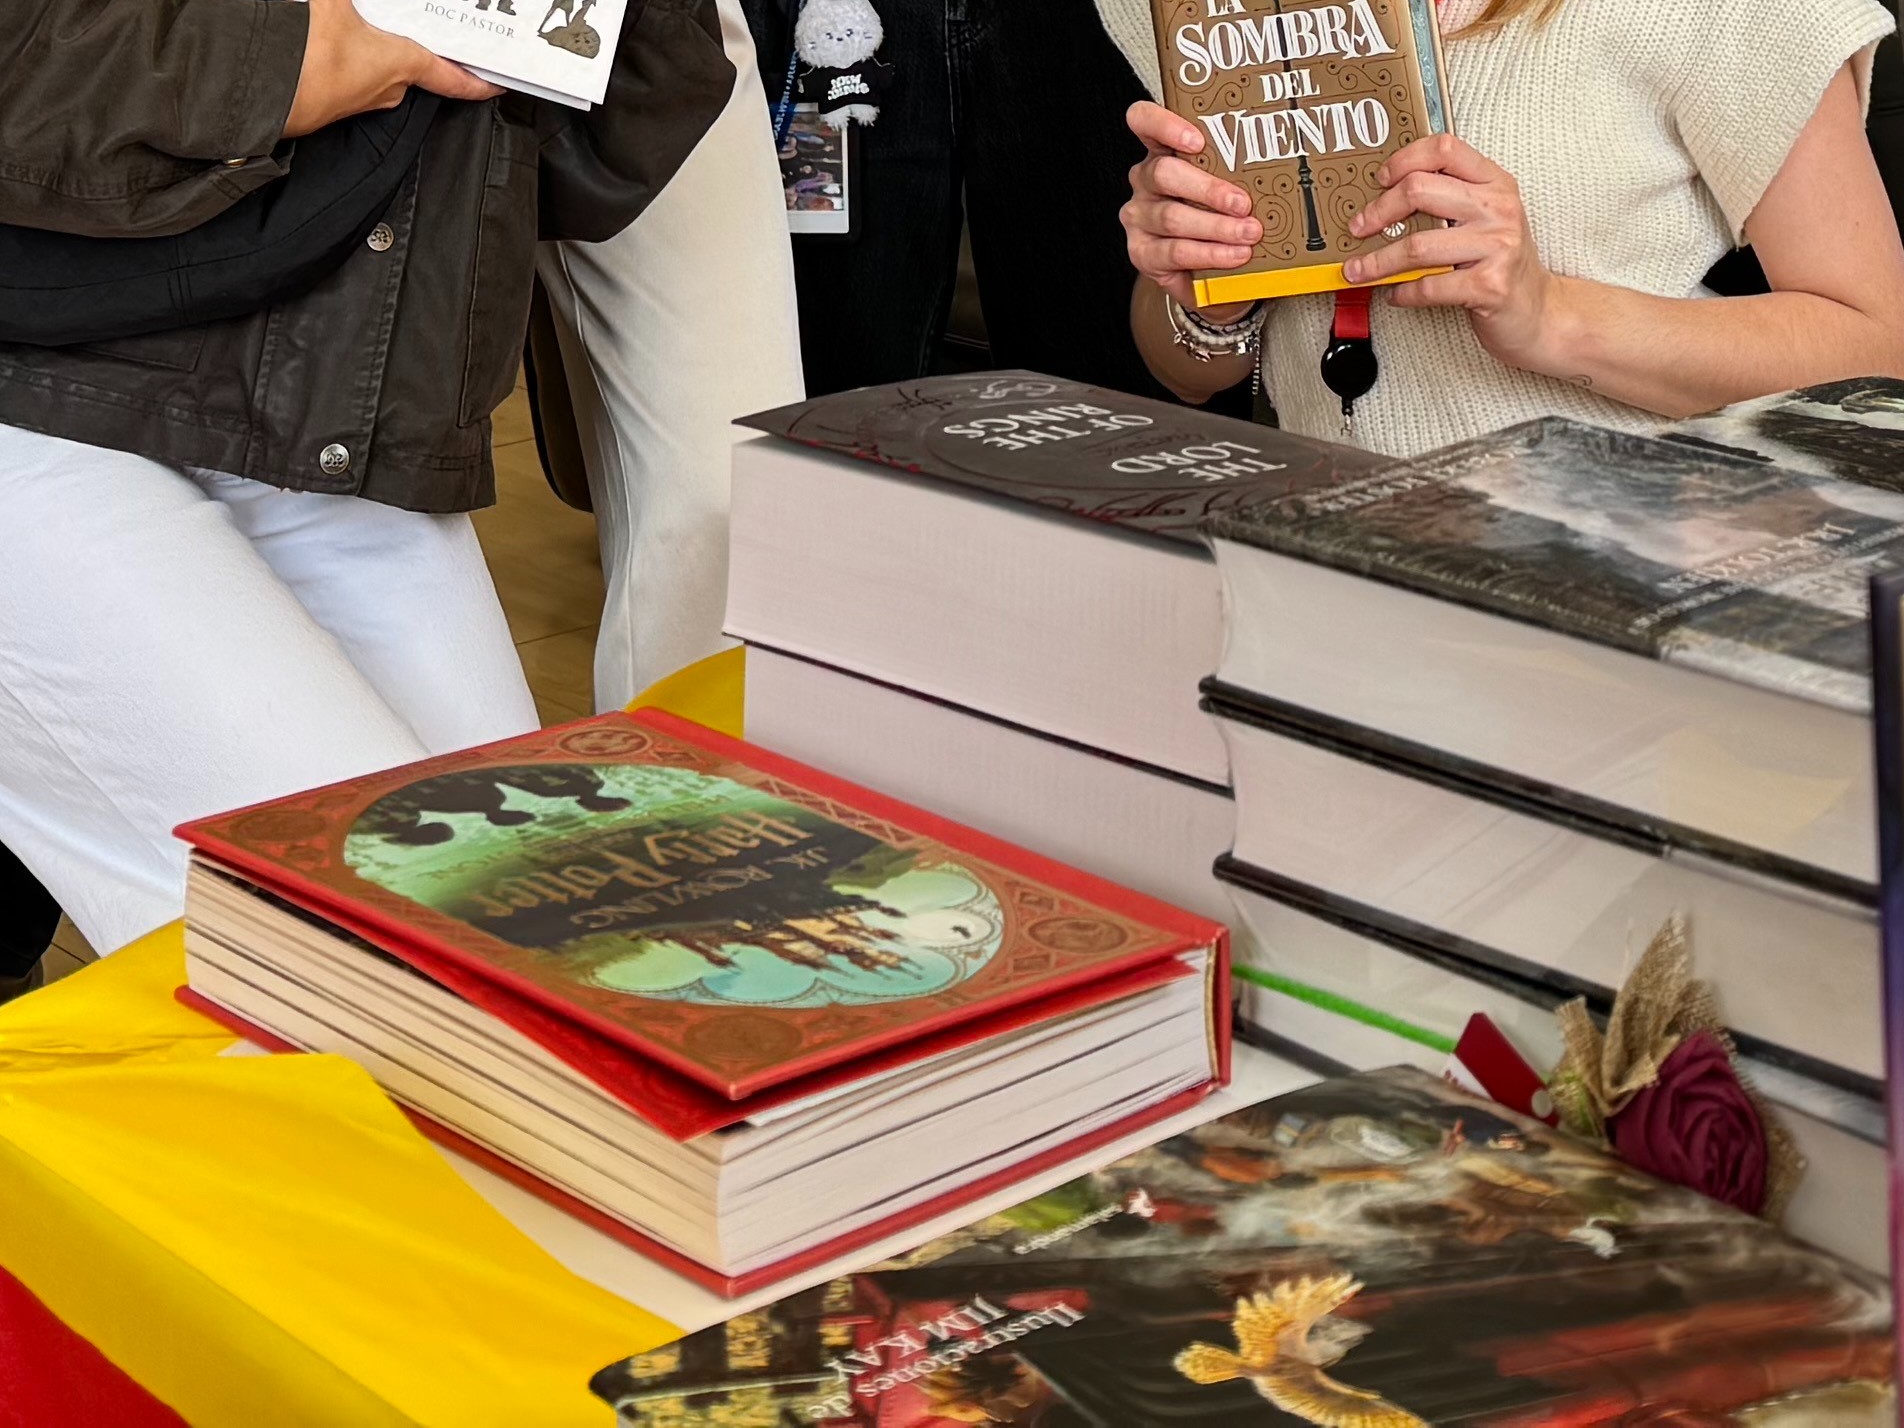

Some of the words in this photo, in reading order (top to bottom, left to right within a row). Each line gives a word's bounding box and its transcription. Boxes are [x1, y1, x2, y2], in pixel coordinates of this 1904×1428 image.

[424, 1, 457, 23] DOC
[460, 11, 516, 39] PASTOR
[1259, 69, 1322, 104] DEL
[1197, 97, 1391, 174] VIENTO
[943, 402, 1113, 439] RINGS
[982, 424, 1092, 452] THE
[1091, 413, 1155, 432] OF
[1111, 441, 1262, 474] LORD
[1178, 456, 1288, 483] THE
[644, 811, 814, 866] Harry
[483, 841, 683, 917] Potter
[570, 863, 774, 929] ROWLING
[919, 1293, 1009, 1341] JIM
[824, 1332, 928, 1383] KAY
[855, 1301, 1087, 1398] Ilustraciones
[806, 1393, 854, 1420] de
